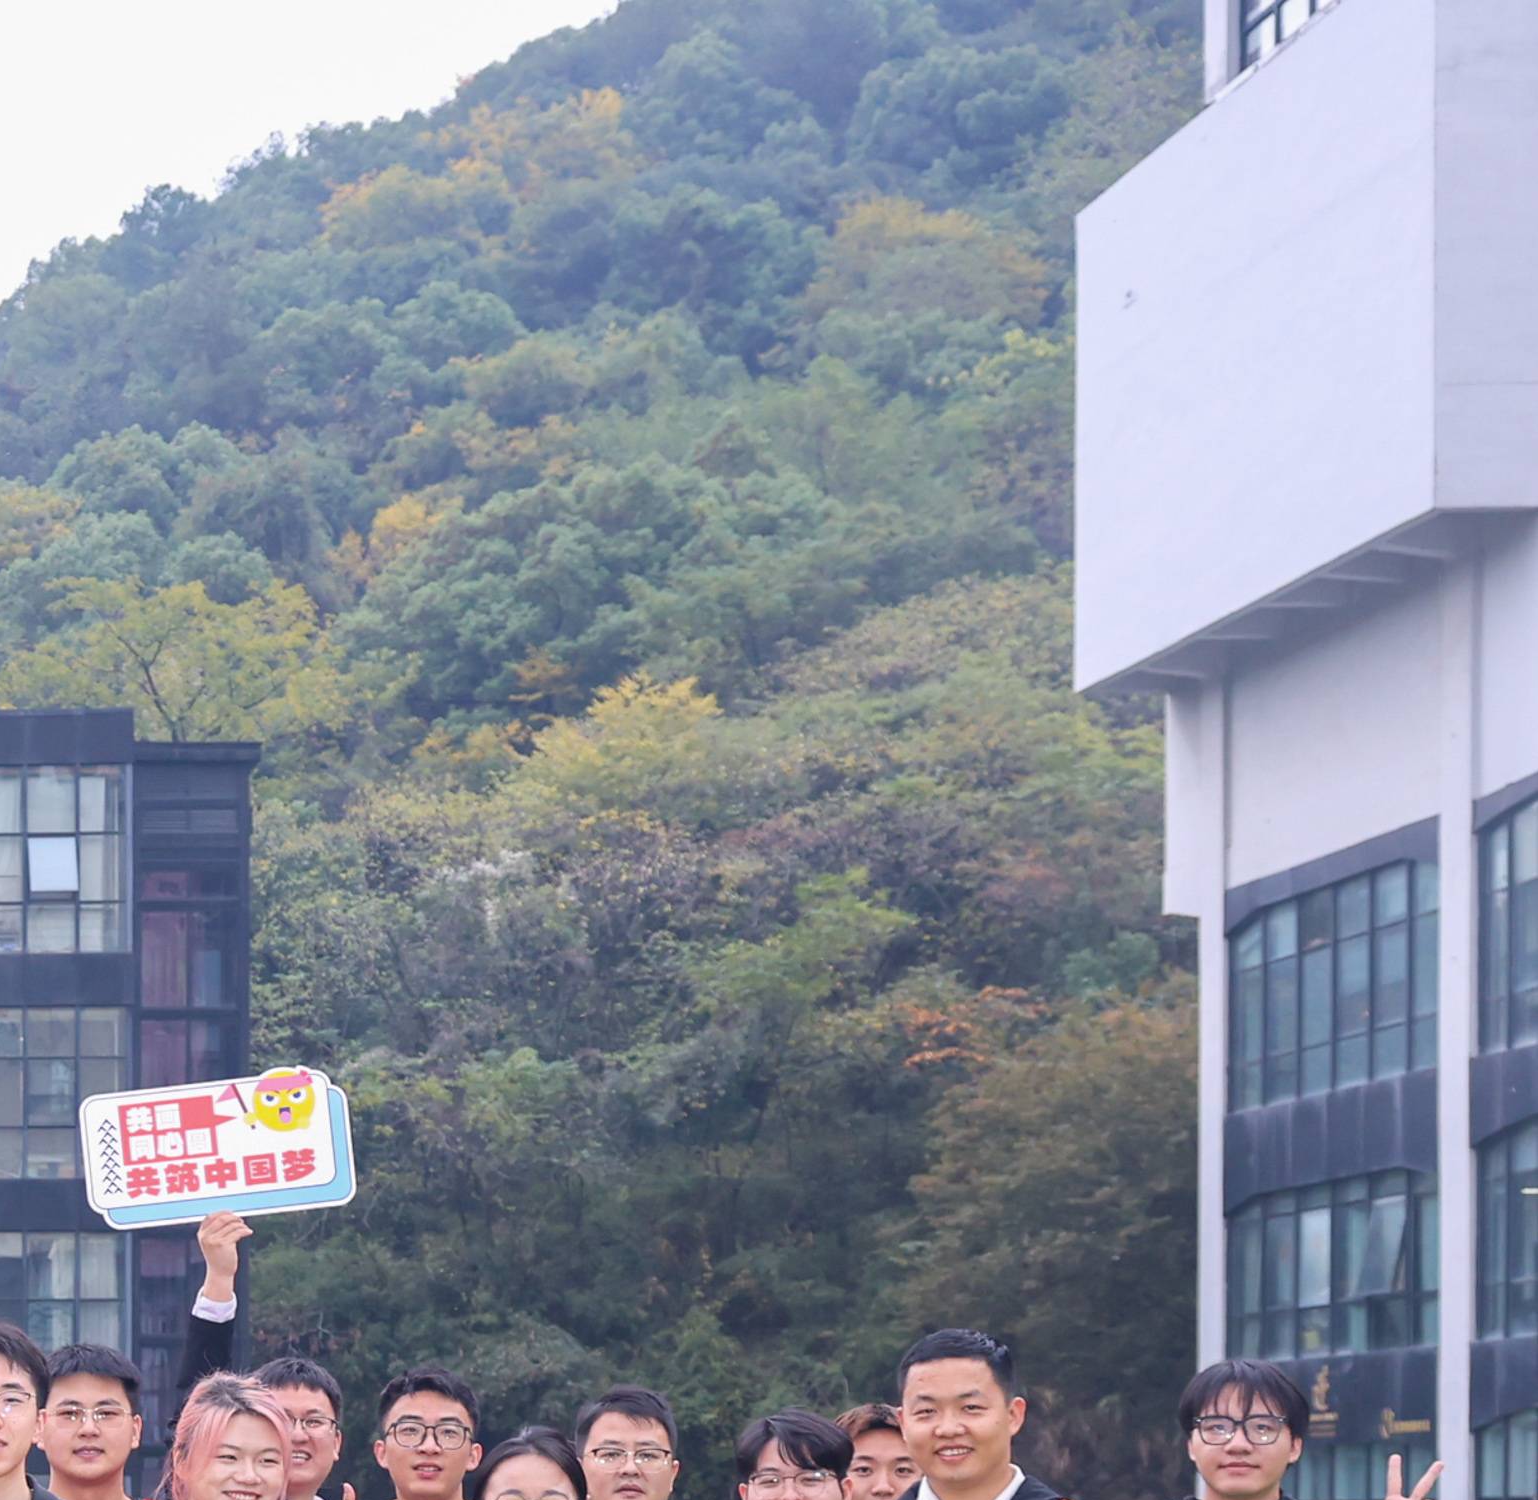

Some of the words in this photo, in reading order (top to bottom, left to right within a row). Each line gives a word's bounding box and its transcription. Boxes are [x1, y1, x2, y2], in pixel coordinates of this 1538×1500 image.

[125, 1102, 182, 1134] 共画
[128, 1127, 214, 1162] 同心圆
[126, 1147, 316, 1199] 共筑中国梦
